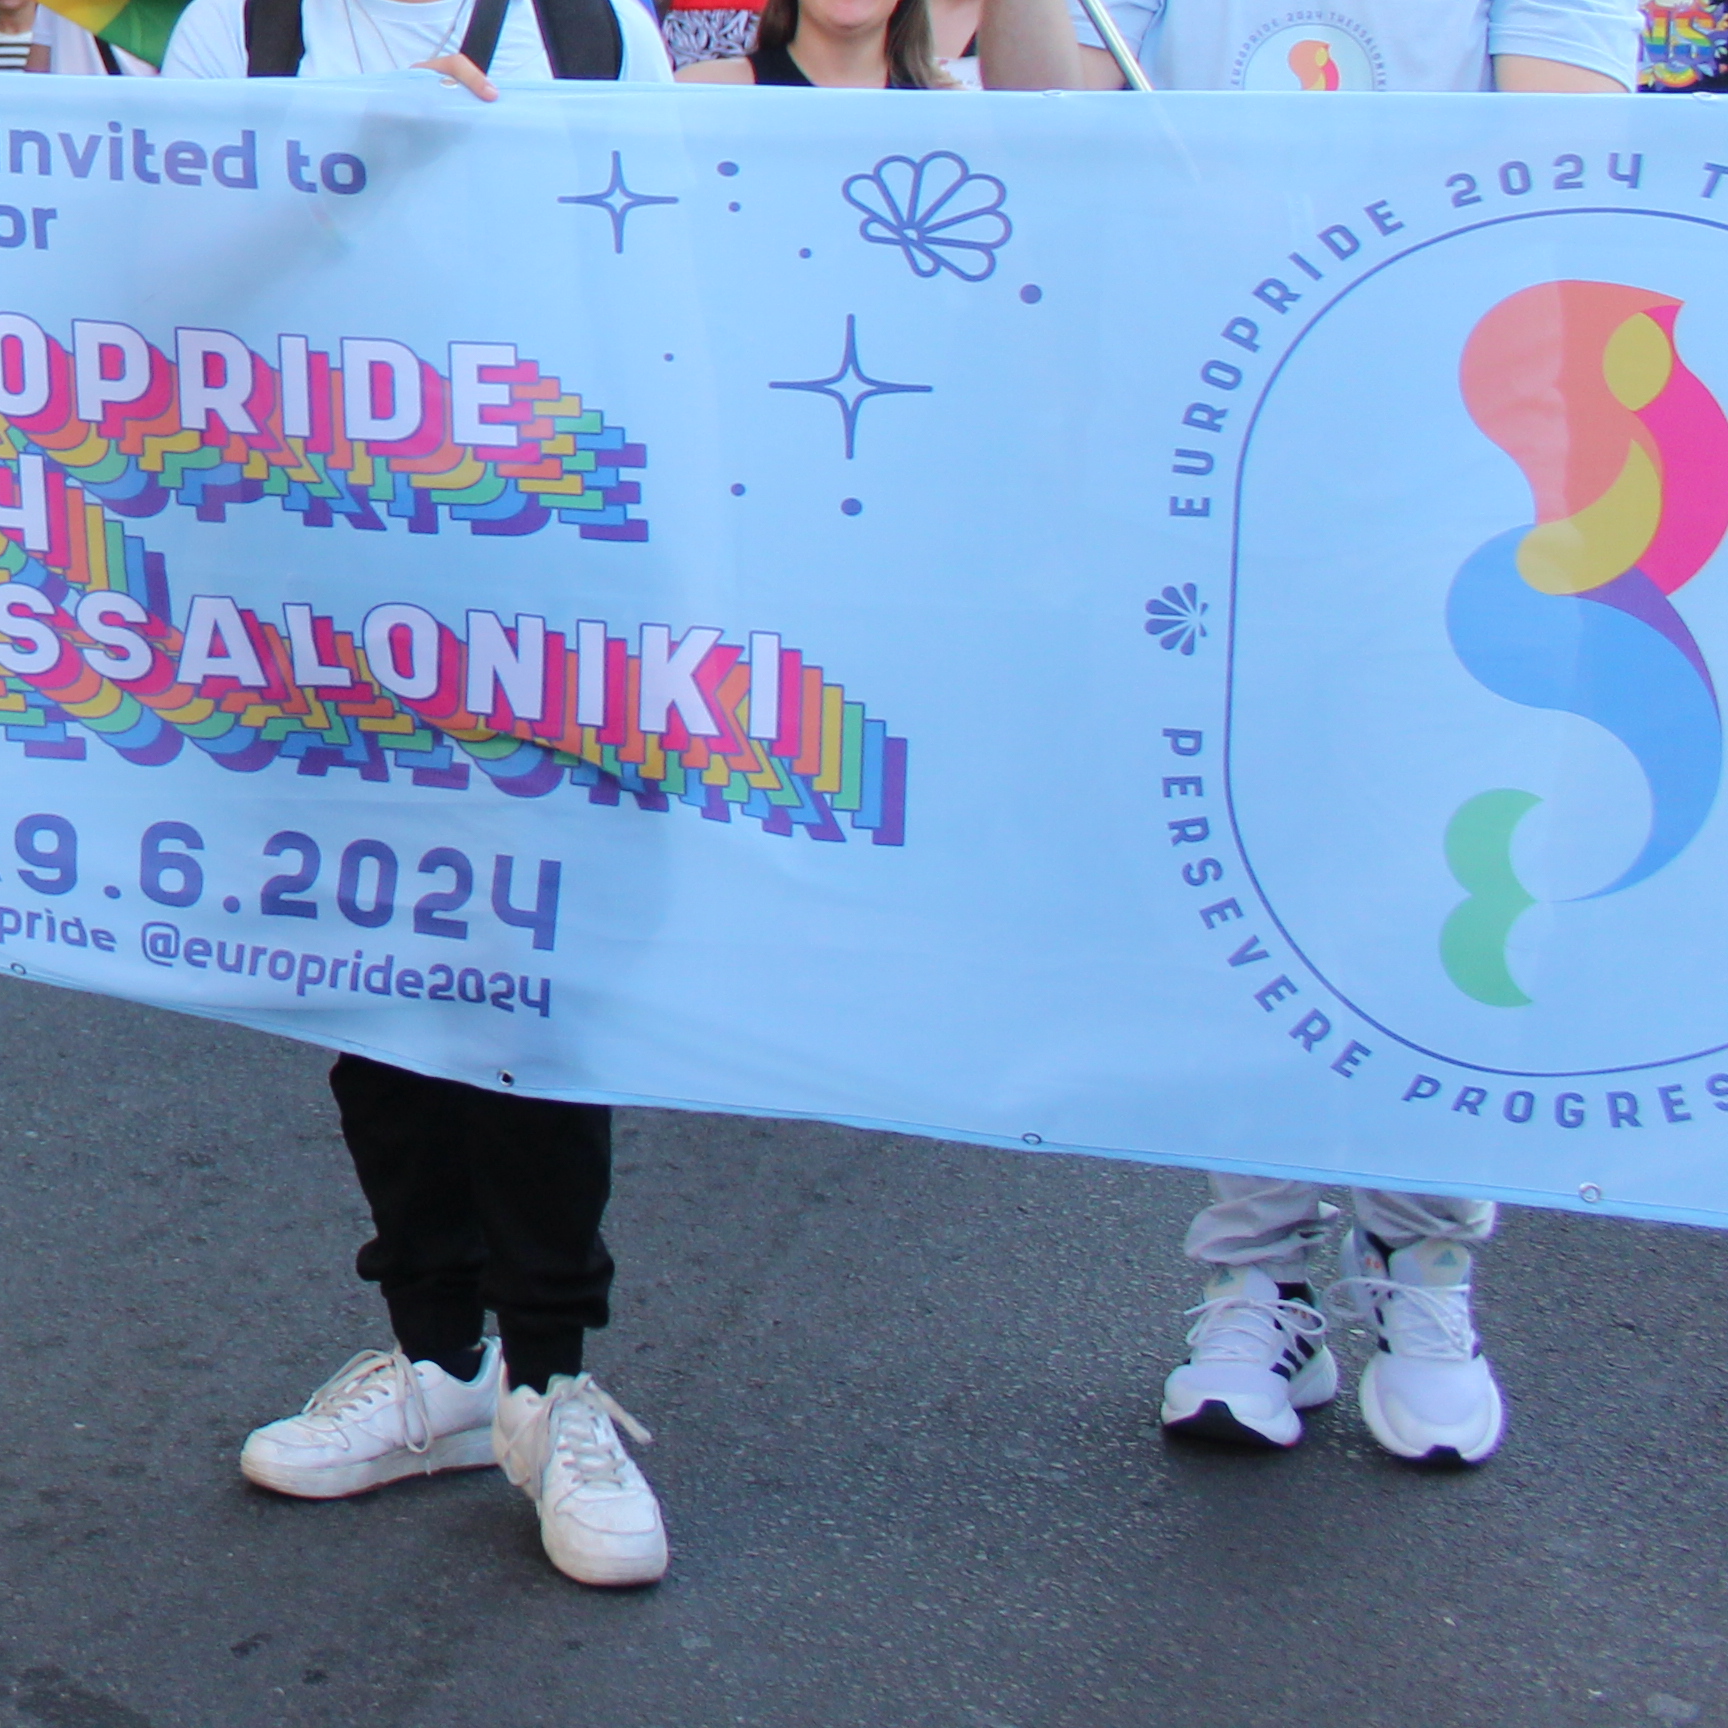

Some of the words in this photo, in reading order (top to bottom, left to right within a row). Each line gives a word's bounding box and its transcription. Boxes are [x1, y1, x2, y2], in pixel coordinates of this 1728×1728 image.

[286, 139, 368, 196] to
[1169, 199, 1405, 518] EUROPRIDE
[1445, 153, 1644, 208] 2024
[141, 920, 552, 1020] @europride2024
[1161, 727, 1372, 1079] PERSEVERE
